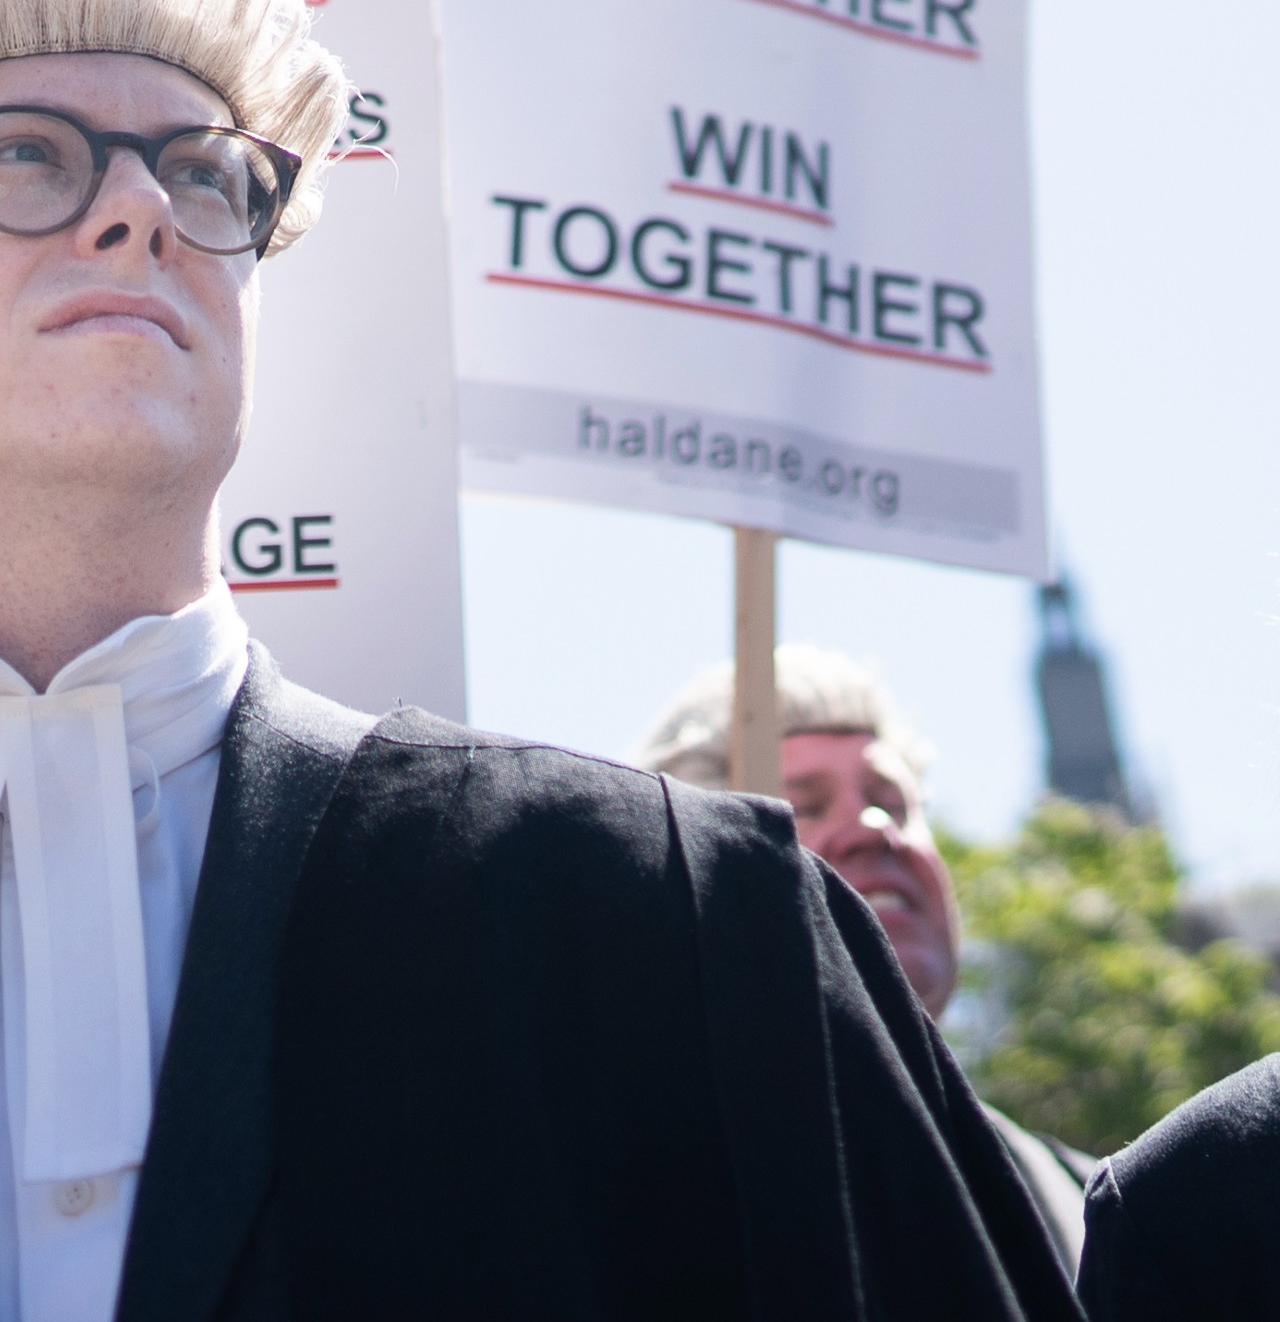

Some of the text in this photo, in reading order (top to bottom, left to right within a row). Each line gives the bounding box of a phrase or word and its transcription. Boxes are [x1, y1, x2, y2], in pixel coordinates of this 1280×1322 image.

[670, 105, 831, 211] WIN
[491, 192, 991, 359] TOGETHER
[577, 405, 902, 516] haldane.org
